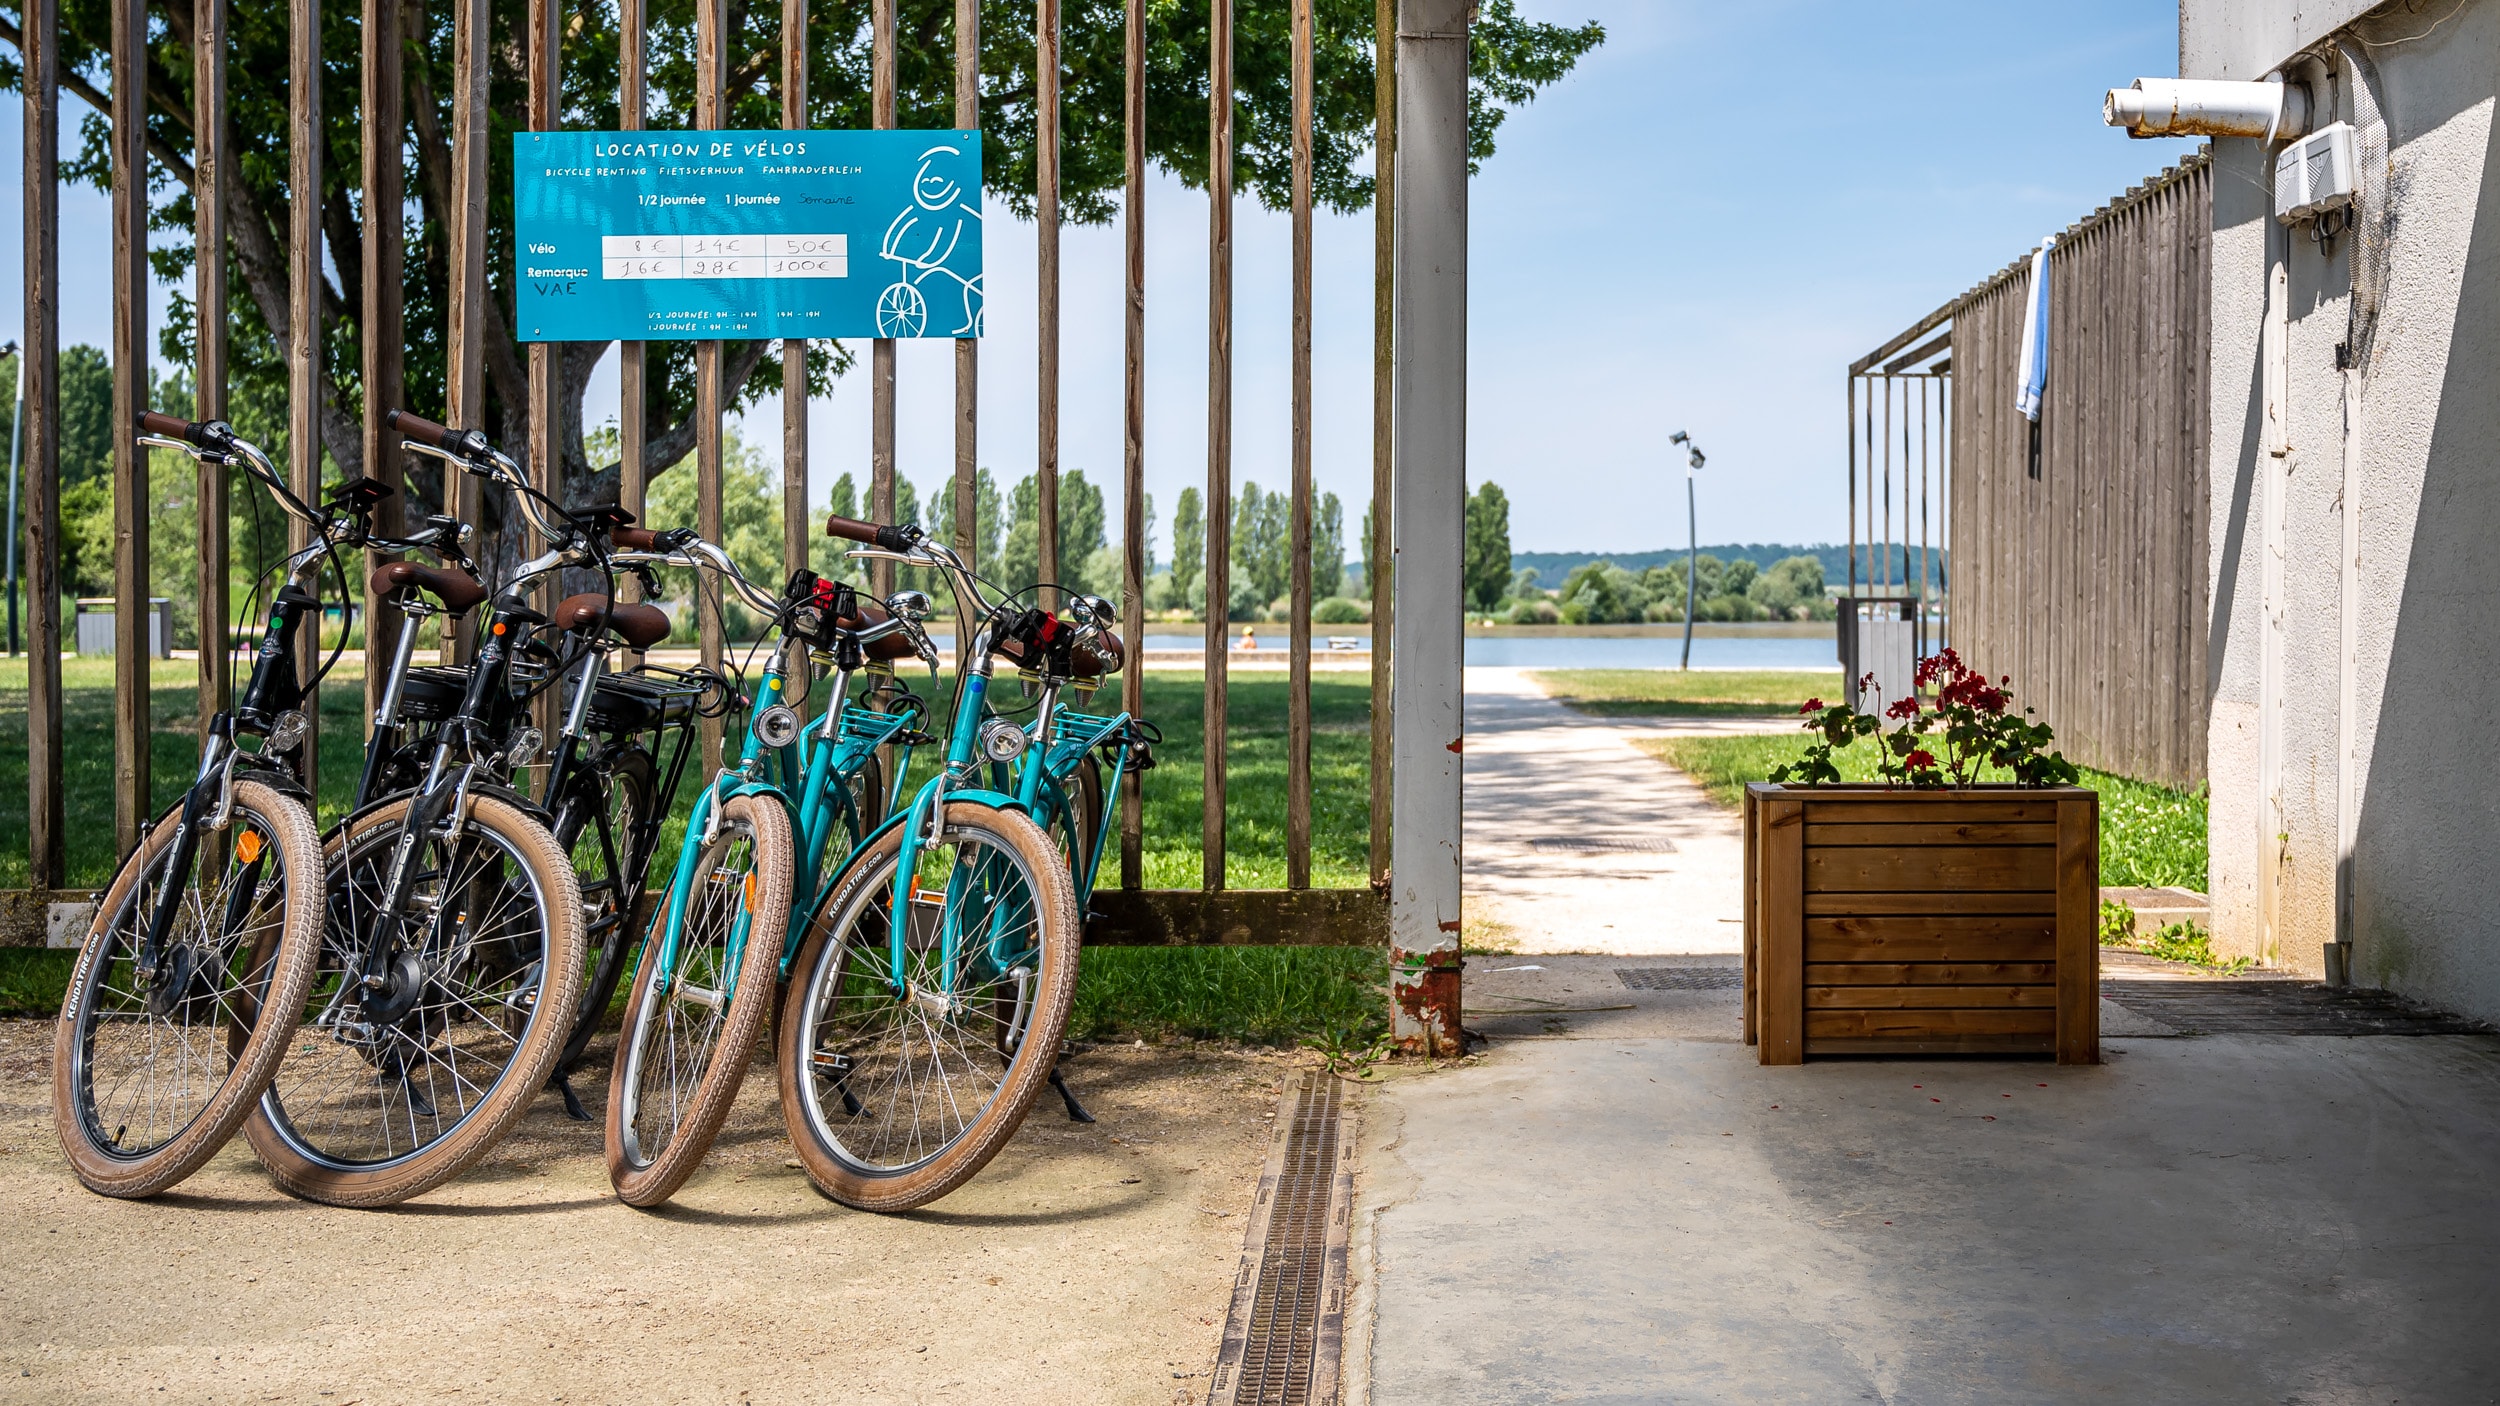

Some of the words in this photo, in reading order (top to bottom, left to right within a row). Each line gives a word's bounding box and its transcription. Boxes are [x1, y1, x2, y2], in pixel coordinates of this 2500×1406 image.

[595, 143, 700, 158] LOCATION
[709, 142, 733, 158] DE
[743, 139, 807, 158] VÉLOS
[545, 167, 592, 177] BICYCLE
[596, 167, 647, 176] RENTING
[659, 166, 745, 176] FIETSVERHUUR
[762, 165, 863, 175] FAHRRADVERLEIH
[638, 194, 658, 207] 1/2
[660, 193, 706, 208] journée
[725, 194, 731, 205] 1
[734, 192, 781, 207] journée
[528, 242, 557, 255] Vélo
[534, 281, 577, 297] VAE
[828, 852, 883, 919] KENDATIRE.COM
[67, 932, 101, 1020] KENDATIRE.COM
